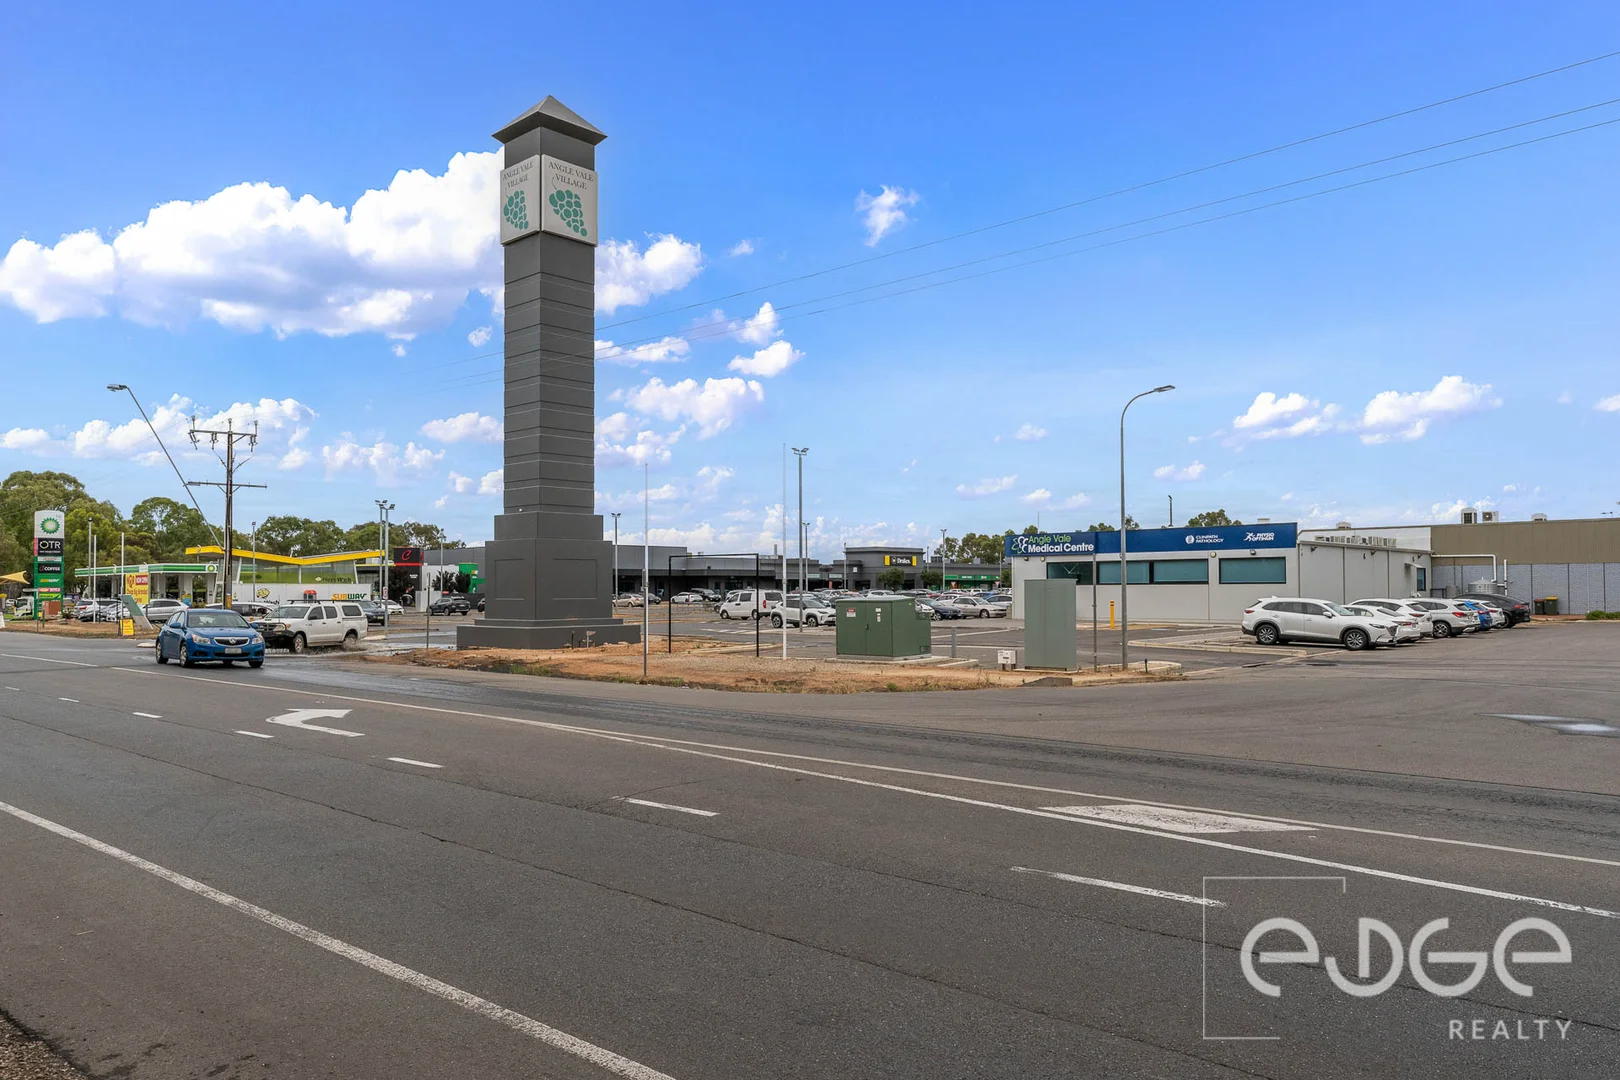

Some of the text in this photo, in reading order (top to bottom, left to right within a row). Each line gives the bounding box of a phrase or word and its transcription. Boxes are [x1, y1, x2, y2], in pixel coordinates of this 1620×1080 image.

[503, 161, 534, 181] ANGLE VALE
[548, 161, 594, 182] ANGLE VALE
[507, 174, 529, 189] VILLAGE
[555, 173, 587, 190] VILLAGE
[39, 540, 60, 549] OTR
[1028, 534, 1072, 545] Angle Vale
[1028, 543, 1094, 553] Medical Centre
[331, 593, 367, 601] SUBWAY
